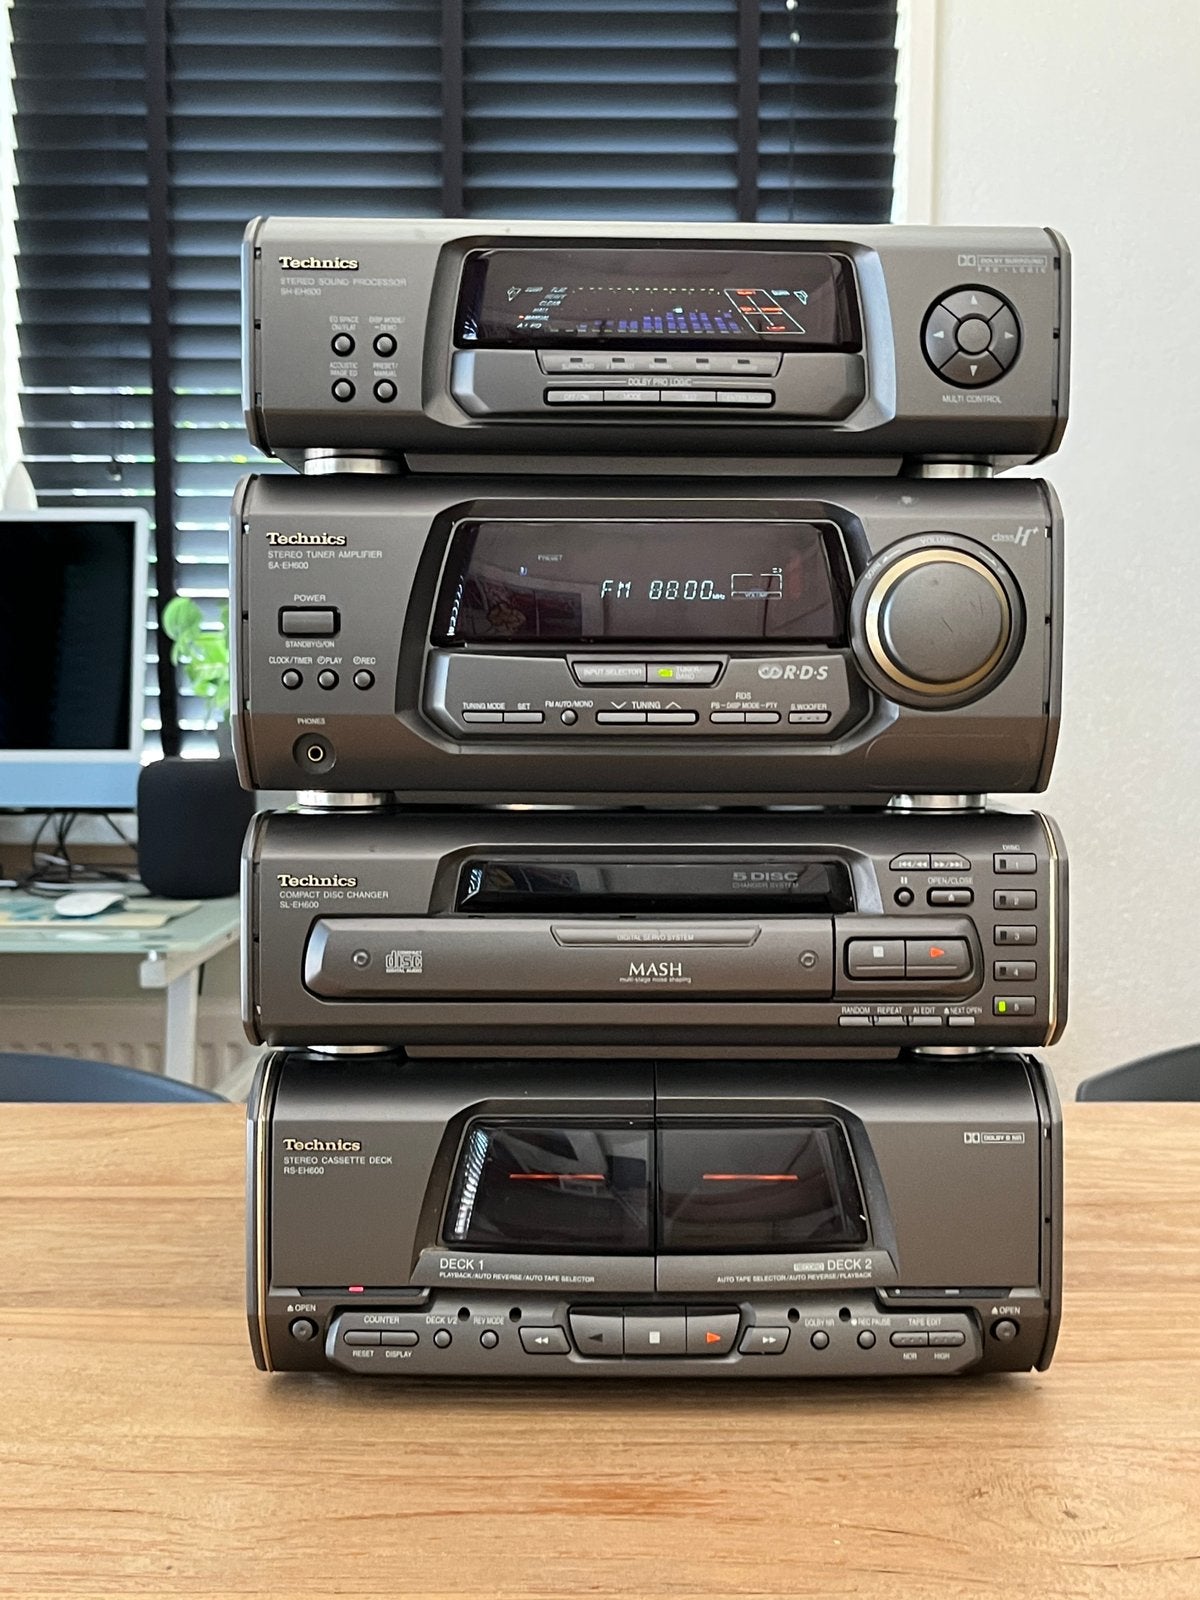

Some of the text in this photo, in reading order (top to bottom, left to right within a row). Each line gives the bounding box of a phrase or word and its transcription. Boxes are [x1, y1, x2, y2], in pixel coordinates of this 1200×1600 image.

[278, 256, 359, 270] Technics
[280, 277, 407, 287] STEREO SOUND PROCESSOR
[627, 378, 651, 386] DOLBY
[670, 379, 692, 387] LOGIC
[942, 394, 1002, 404] MULTI CONTROL
[266, 532, 346, 546] Technics
[268, 550, 383, 559] STEREO TUNER AMPLIFIER
[268, 561, 309, 570] SA-EH600
[601, 580, 631, 599] FM
[293, 594, 327, 602] POWER
[268, 656, 313, 664] CLOCK/TIMER
[583, 668, 642, 676] INPUT SELECTOR
[735, 692, 752, 700] RDS
[462, 702, 486, 710] TUNING
[518, 702, 531, 710] SET
[631, 701, 661, 709] TUNING
[297, 717, 326, 725] PHONES
[732, 871, 799, 881] 5 DISC
[277, 874, 357, 888] Technics
[927, 876, 974, 885] OPEN/CLOSE
[279, 891, 389, 899] COMPACT DISC CHANGER
[279, 901, 319, 909] SL-EH600
[628, 962, 682, 977] MASH
[841, 1006, 871, 1014] RANDOM
[876, 1006, 903, 1014] REPEAT
[282, 1138, 361, 1151] Technics
[283, 1156, 393, 1164] STEREO CASSETTE DECK
[283, 1166, 325, 1175] RS-EH600
[439, 1258, 484, 1271] DECK 1
[827, 1259, 862, 1271] DECK
[864, 1258, 873, 1270] 2
[561, 1275, 595, 1283] SELECTOR
[735, 1275, 750, 1283] TAPE
[294, 1304, 317, 1312] OPEN
[999, 1306, 1021, 1315] OPEN
[363, 1315, 400, 1324] COUNTER
[425, 1316, 446, 1324] DECK
[486, 1317, 505, 1325] MODE
[908, 1317, 941, 1326] TAPE EDIT
[352, 1350, 375, 1358] RESET
[385, 1350, 413, 1358] DISPLAY
[933, 1352, 951, 1360] HIGH
